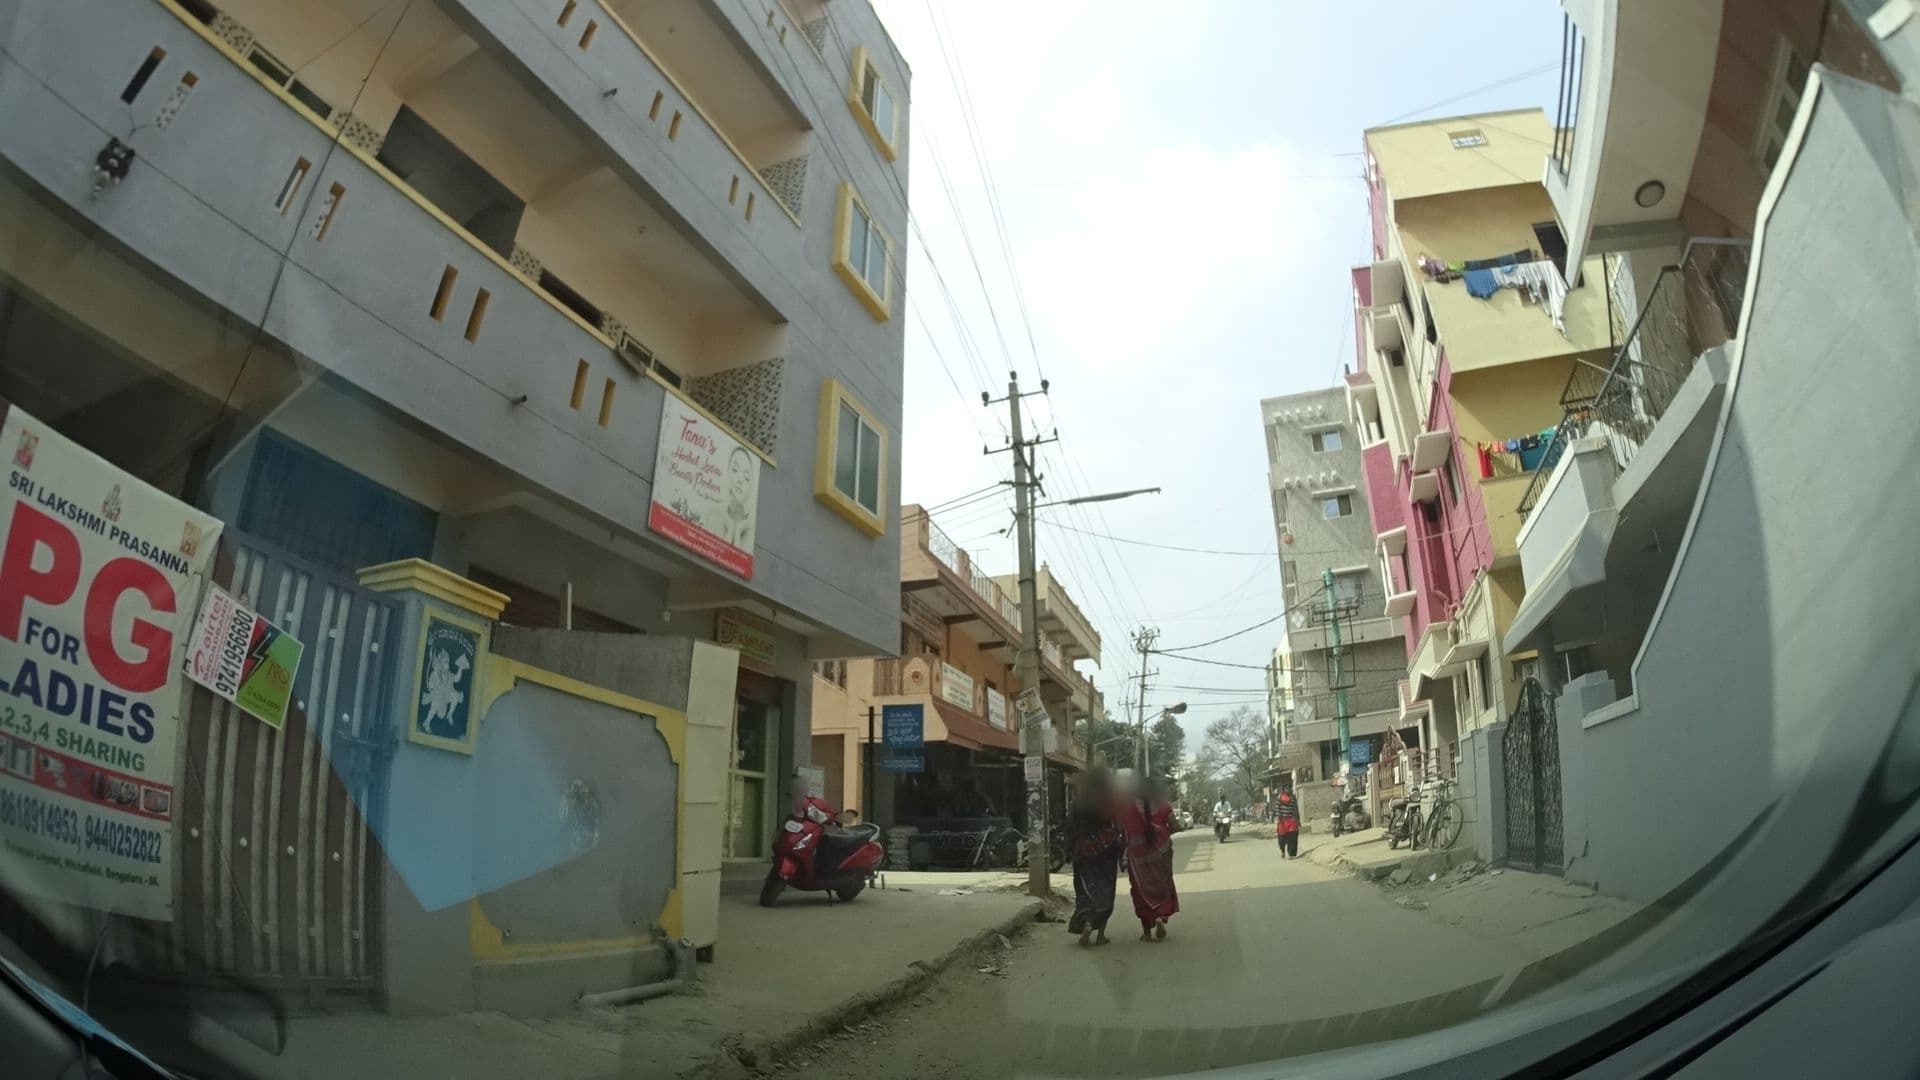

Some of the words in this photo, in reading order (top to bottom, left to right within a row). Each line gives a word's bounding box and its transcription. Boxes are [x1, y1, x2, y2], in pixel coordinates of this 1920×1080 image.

[680, 416, 717, 455] Tanu's
[9, 470, 34, 497] SRI
[37, 487, 106, 536] LAKSHMI
[109, 526, 189, 577] PRASANNA
[0, 500, 177, 694] PG
[203, 594, 224, 649] airtel
[25, 617, 80, 666] FOR
[215, 608, 254, 696] 9741956680
[56, 728, 145, 772] SHARING
[85, 814, 161, 864] 9440252822
